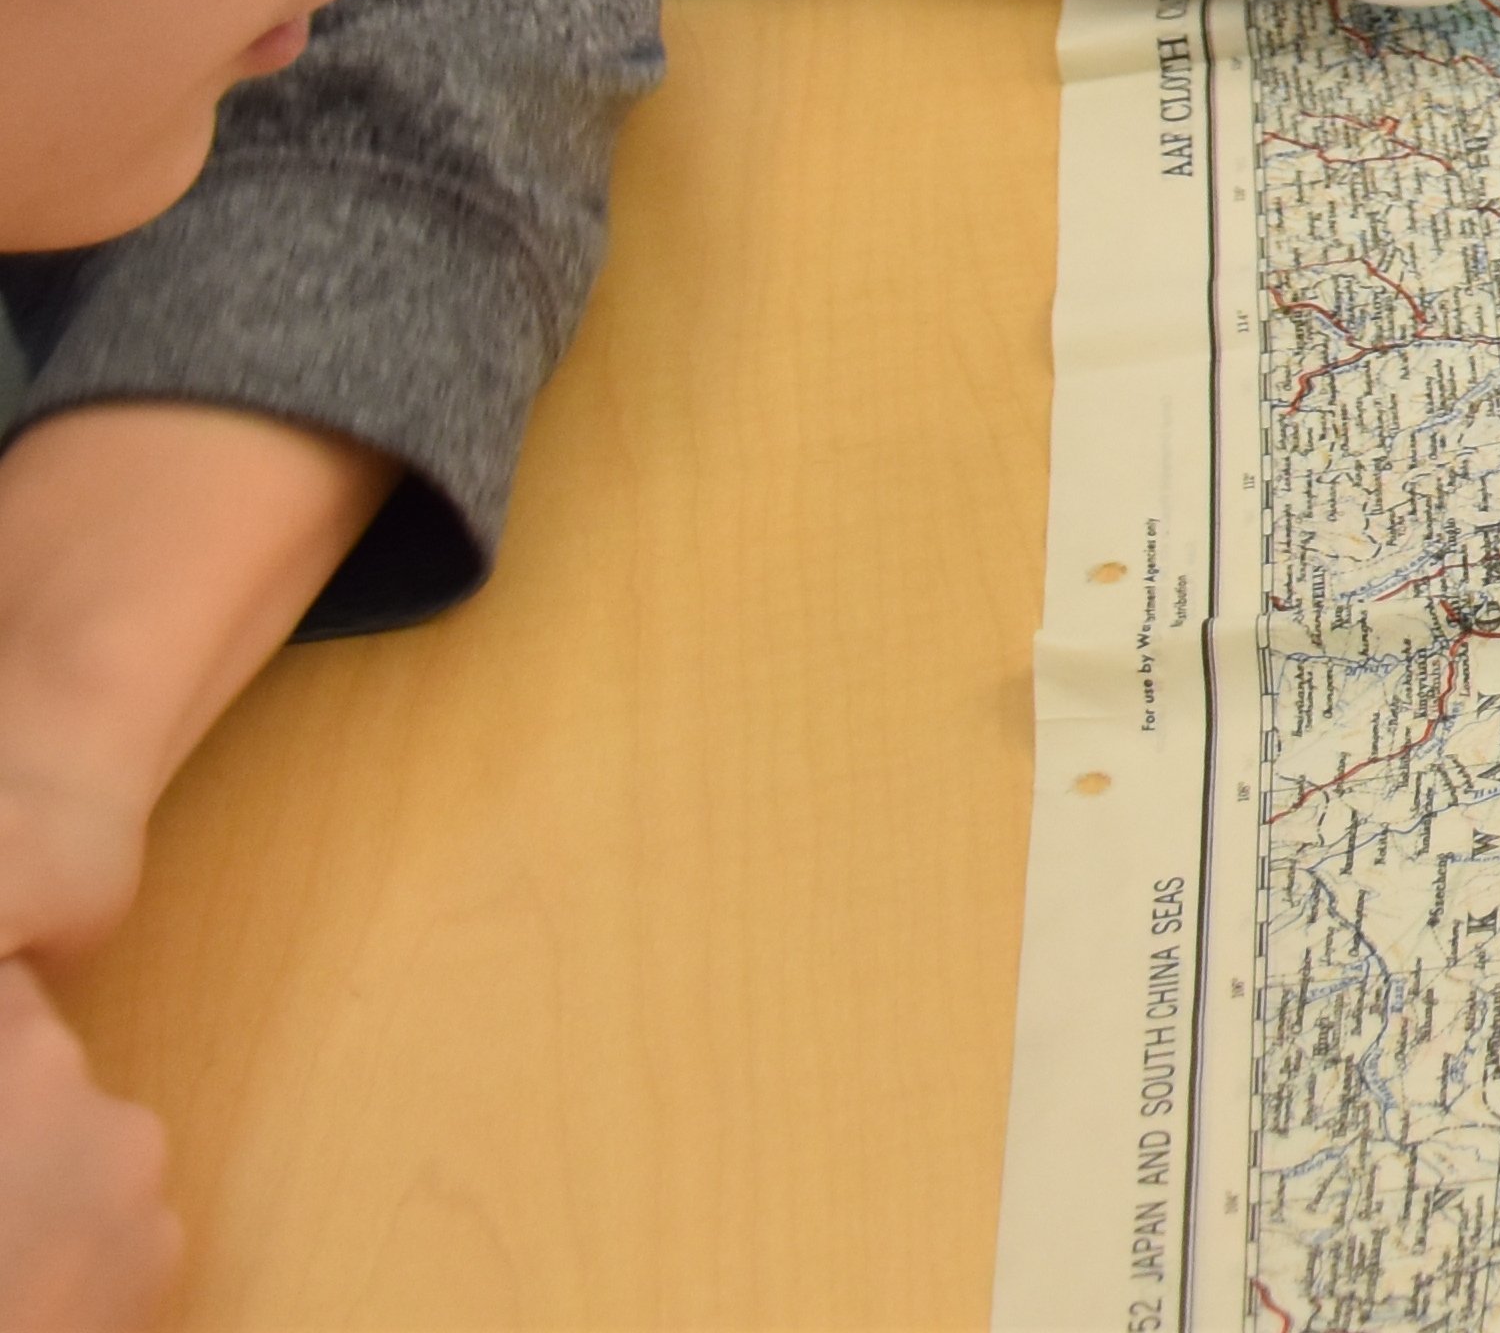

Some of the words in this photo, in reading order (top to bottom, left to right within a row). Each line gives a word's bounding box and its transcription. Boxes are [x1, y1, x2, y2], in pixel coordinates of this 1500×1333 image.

[1157, 34, 1193, 122] CLOTH
[1160, 133, 1193, 177] AAF
[1236, 309, 1251, 333] 114°
[1144, 517, 1159, 537] only
[1143, 540, 1158, 583] Agencies
[1137, 654, 1153, 673] by
[1143, 679, 1155, 704] use
[1141, 709, 1156, 732] For
[1151, 876, 1185, 933] SEAS
[1146, 945, 1181, 1019] CHINA
[1140, 1025, 1176, 1116] SOUTH
[1137, 1131, 1171, 1185] AND
[1131, 1200, 1168, 1282] JAPAN
